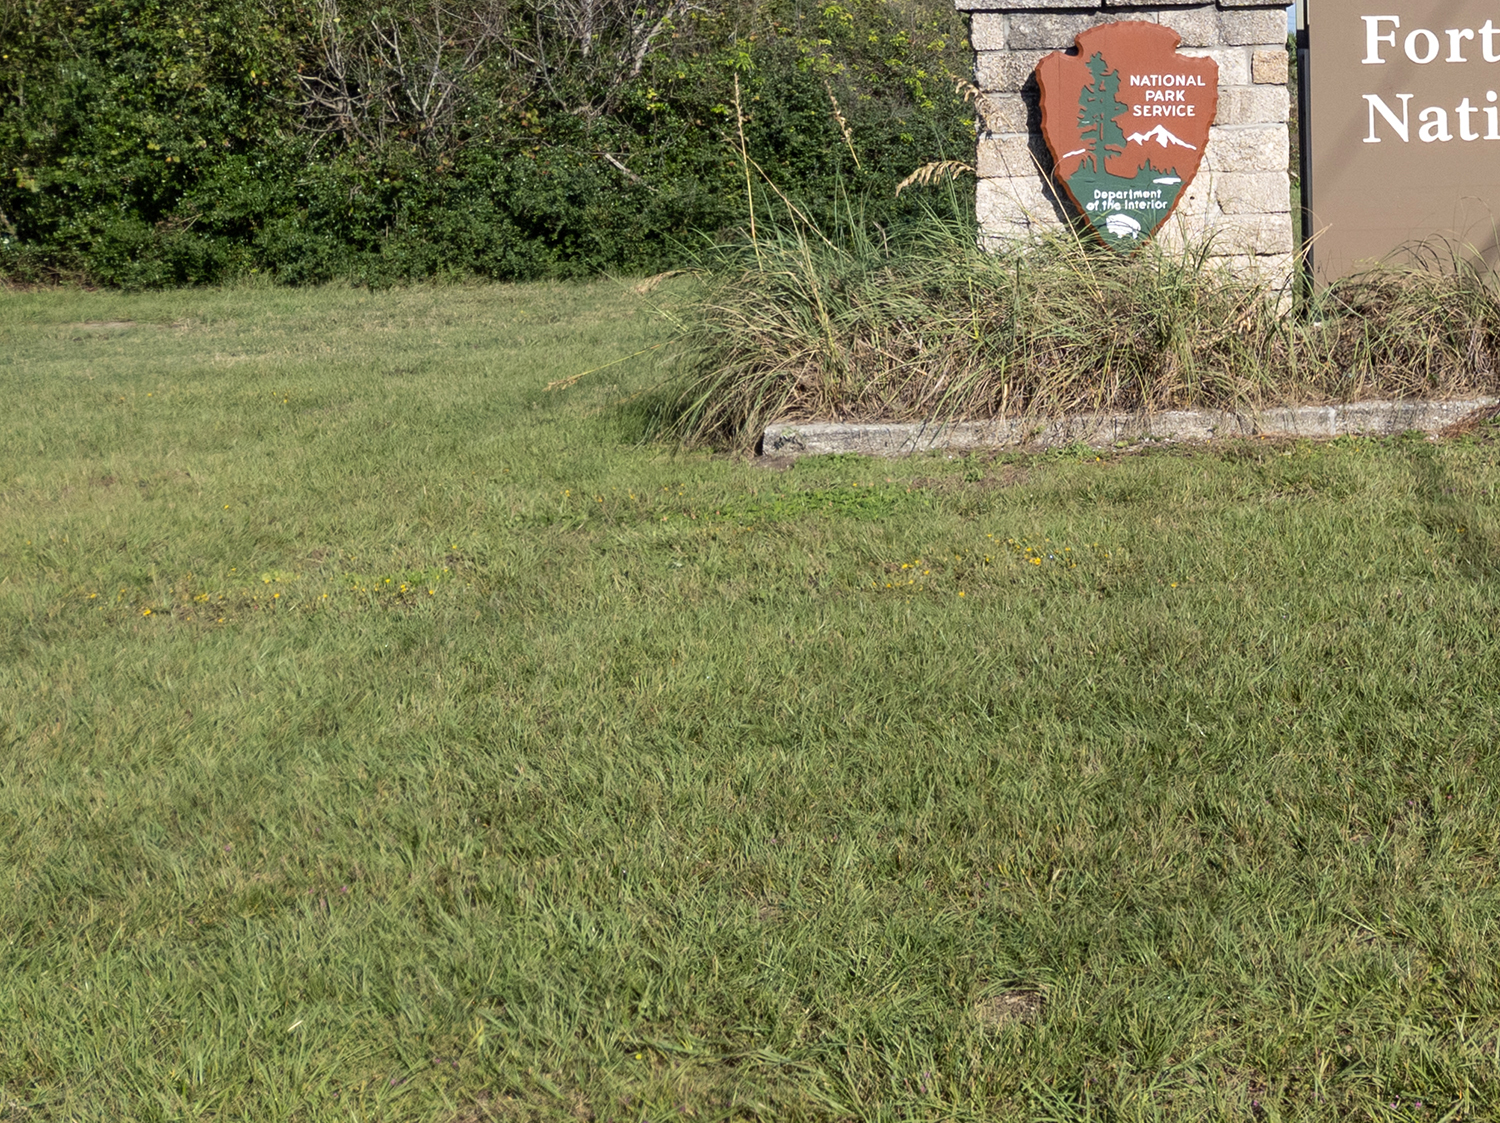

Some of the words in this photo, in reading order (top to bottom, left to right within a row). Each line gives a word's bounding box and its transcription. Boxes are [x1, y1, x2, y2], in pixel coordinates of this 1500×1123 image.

[1130, 74, 1206, 87] NATIONAL
[1145, 89, 1186, 102] PARK
[1132, 104, 1196, 117] SERVICE
[1093, 188, 1162, 202] Department
[1085, 200, 1100, 211] of
[1101, 198, 1121, 211] the
[1124, 199, 1168, 211] Interior
